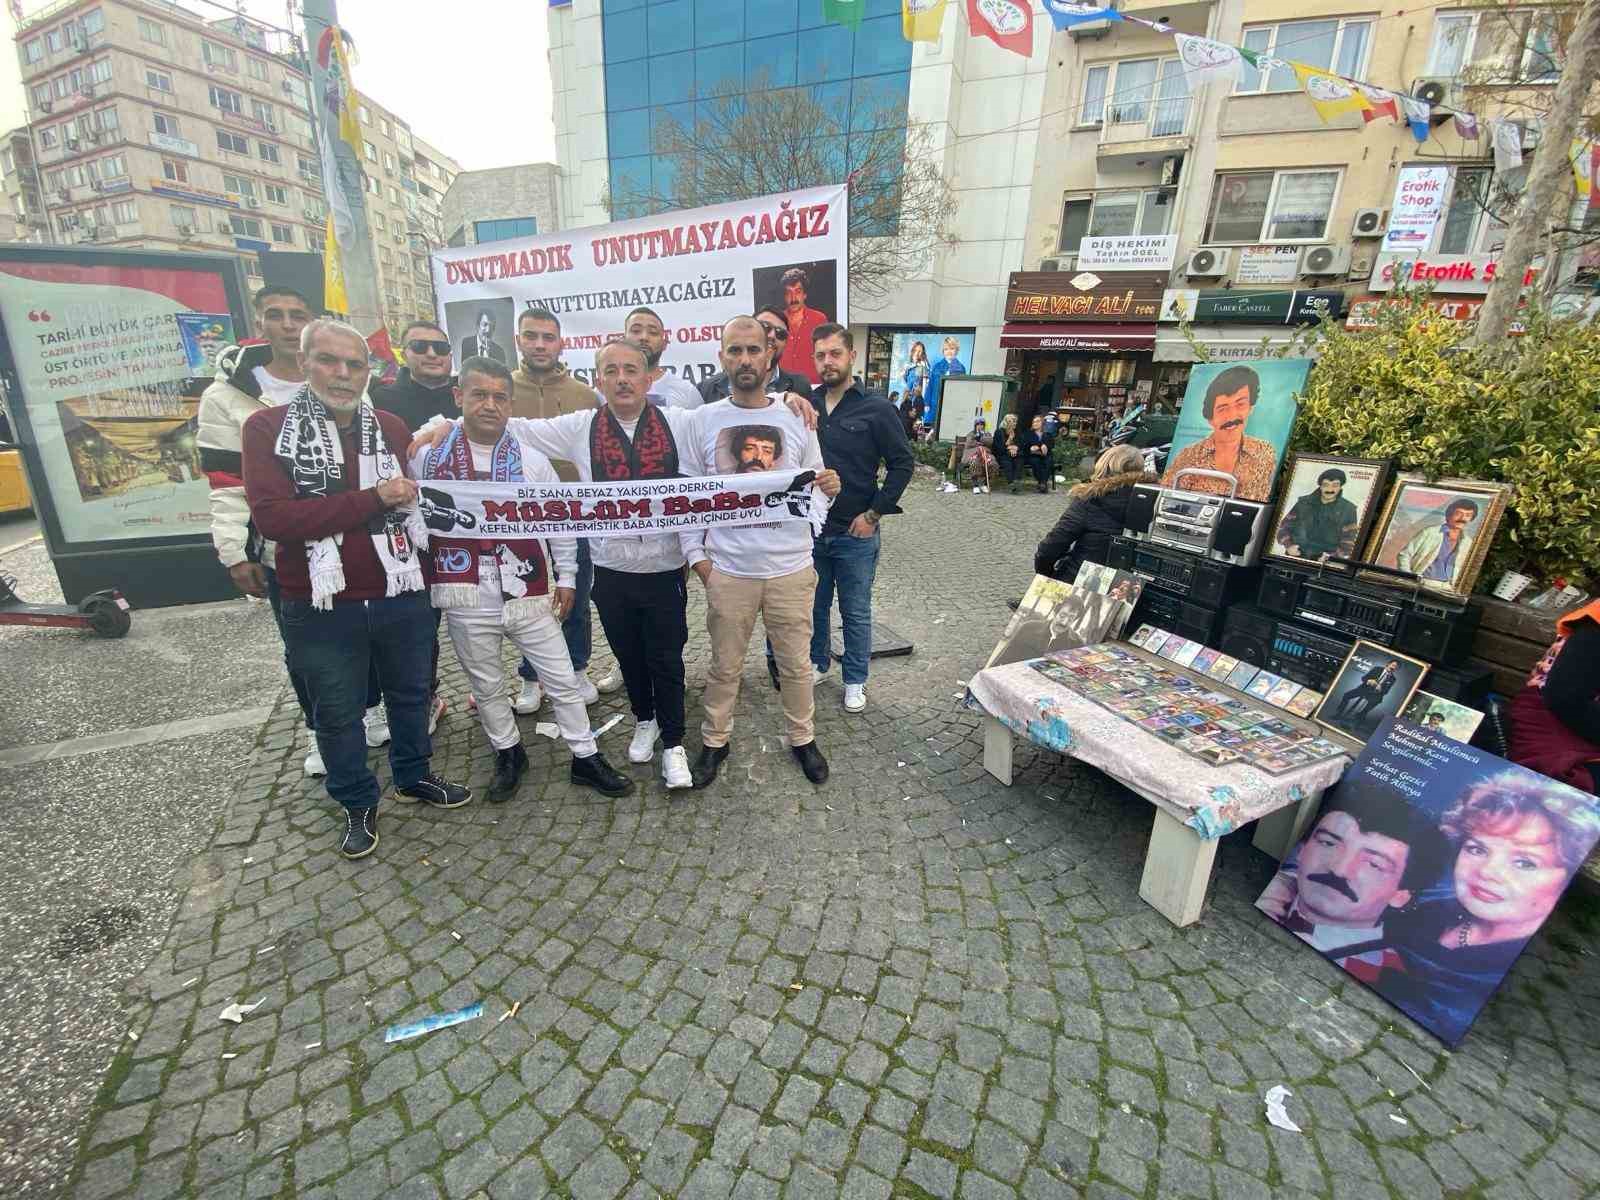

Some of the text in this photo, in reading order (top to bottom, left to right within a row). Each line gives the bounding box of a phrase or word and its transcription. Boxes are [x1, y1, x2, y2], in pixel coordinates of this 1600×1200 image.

[1402, 181, 1440, 191] Erotik
[1400, 195, 1435, 206] Shop
[445, 200, 830, 285] UNUTMADIK UNUTMAYACAĞIZ
[1091, 238, 1168, 249] DİŞ HEKİMİ
[1275, 246, 1297, 254] PEN
[1413, 261, 1476, 281] Erotik
[527, 275, 736, 315] UNUTTURMAYACAĞIZ
[1013, 296, 1094, 316] HELVACI
[1094, 291, 1134, 315] ALİ
[1039, 338, 1066, 346] HELVACI
[518, 481, 724, 498] BİZ SANA BEYAZ YAKIŞIYOR DERKEN
[479, 523, 520, 534] KEFENİ
[623, 519, 653, 530] BABA
[656, 515, 698, 529] IŞIKLAR
[700, 511, 736, 523] İÇİNDE
[739, 508, 763, 519] UYU
[1394, 723, 1430, 743] Radikal
[1425, 747, 1449, 762] Kara
[1365, 767, 1389, 782] Fatih
[1370, 758, 1398, 775] Serhat
